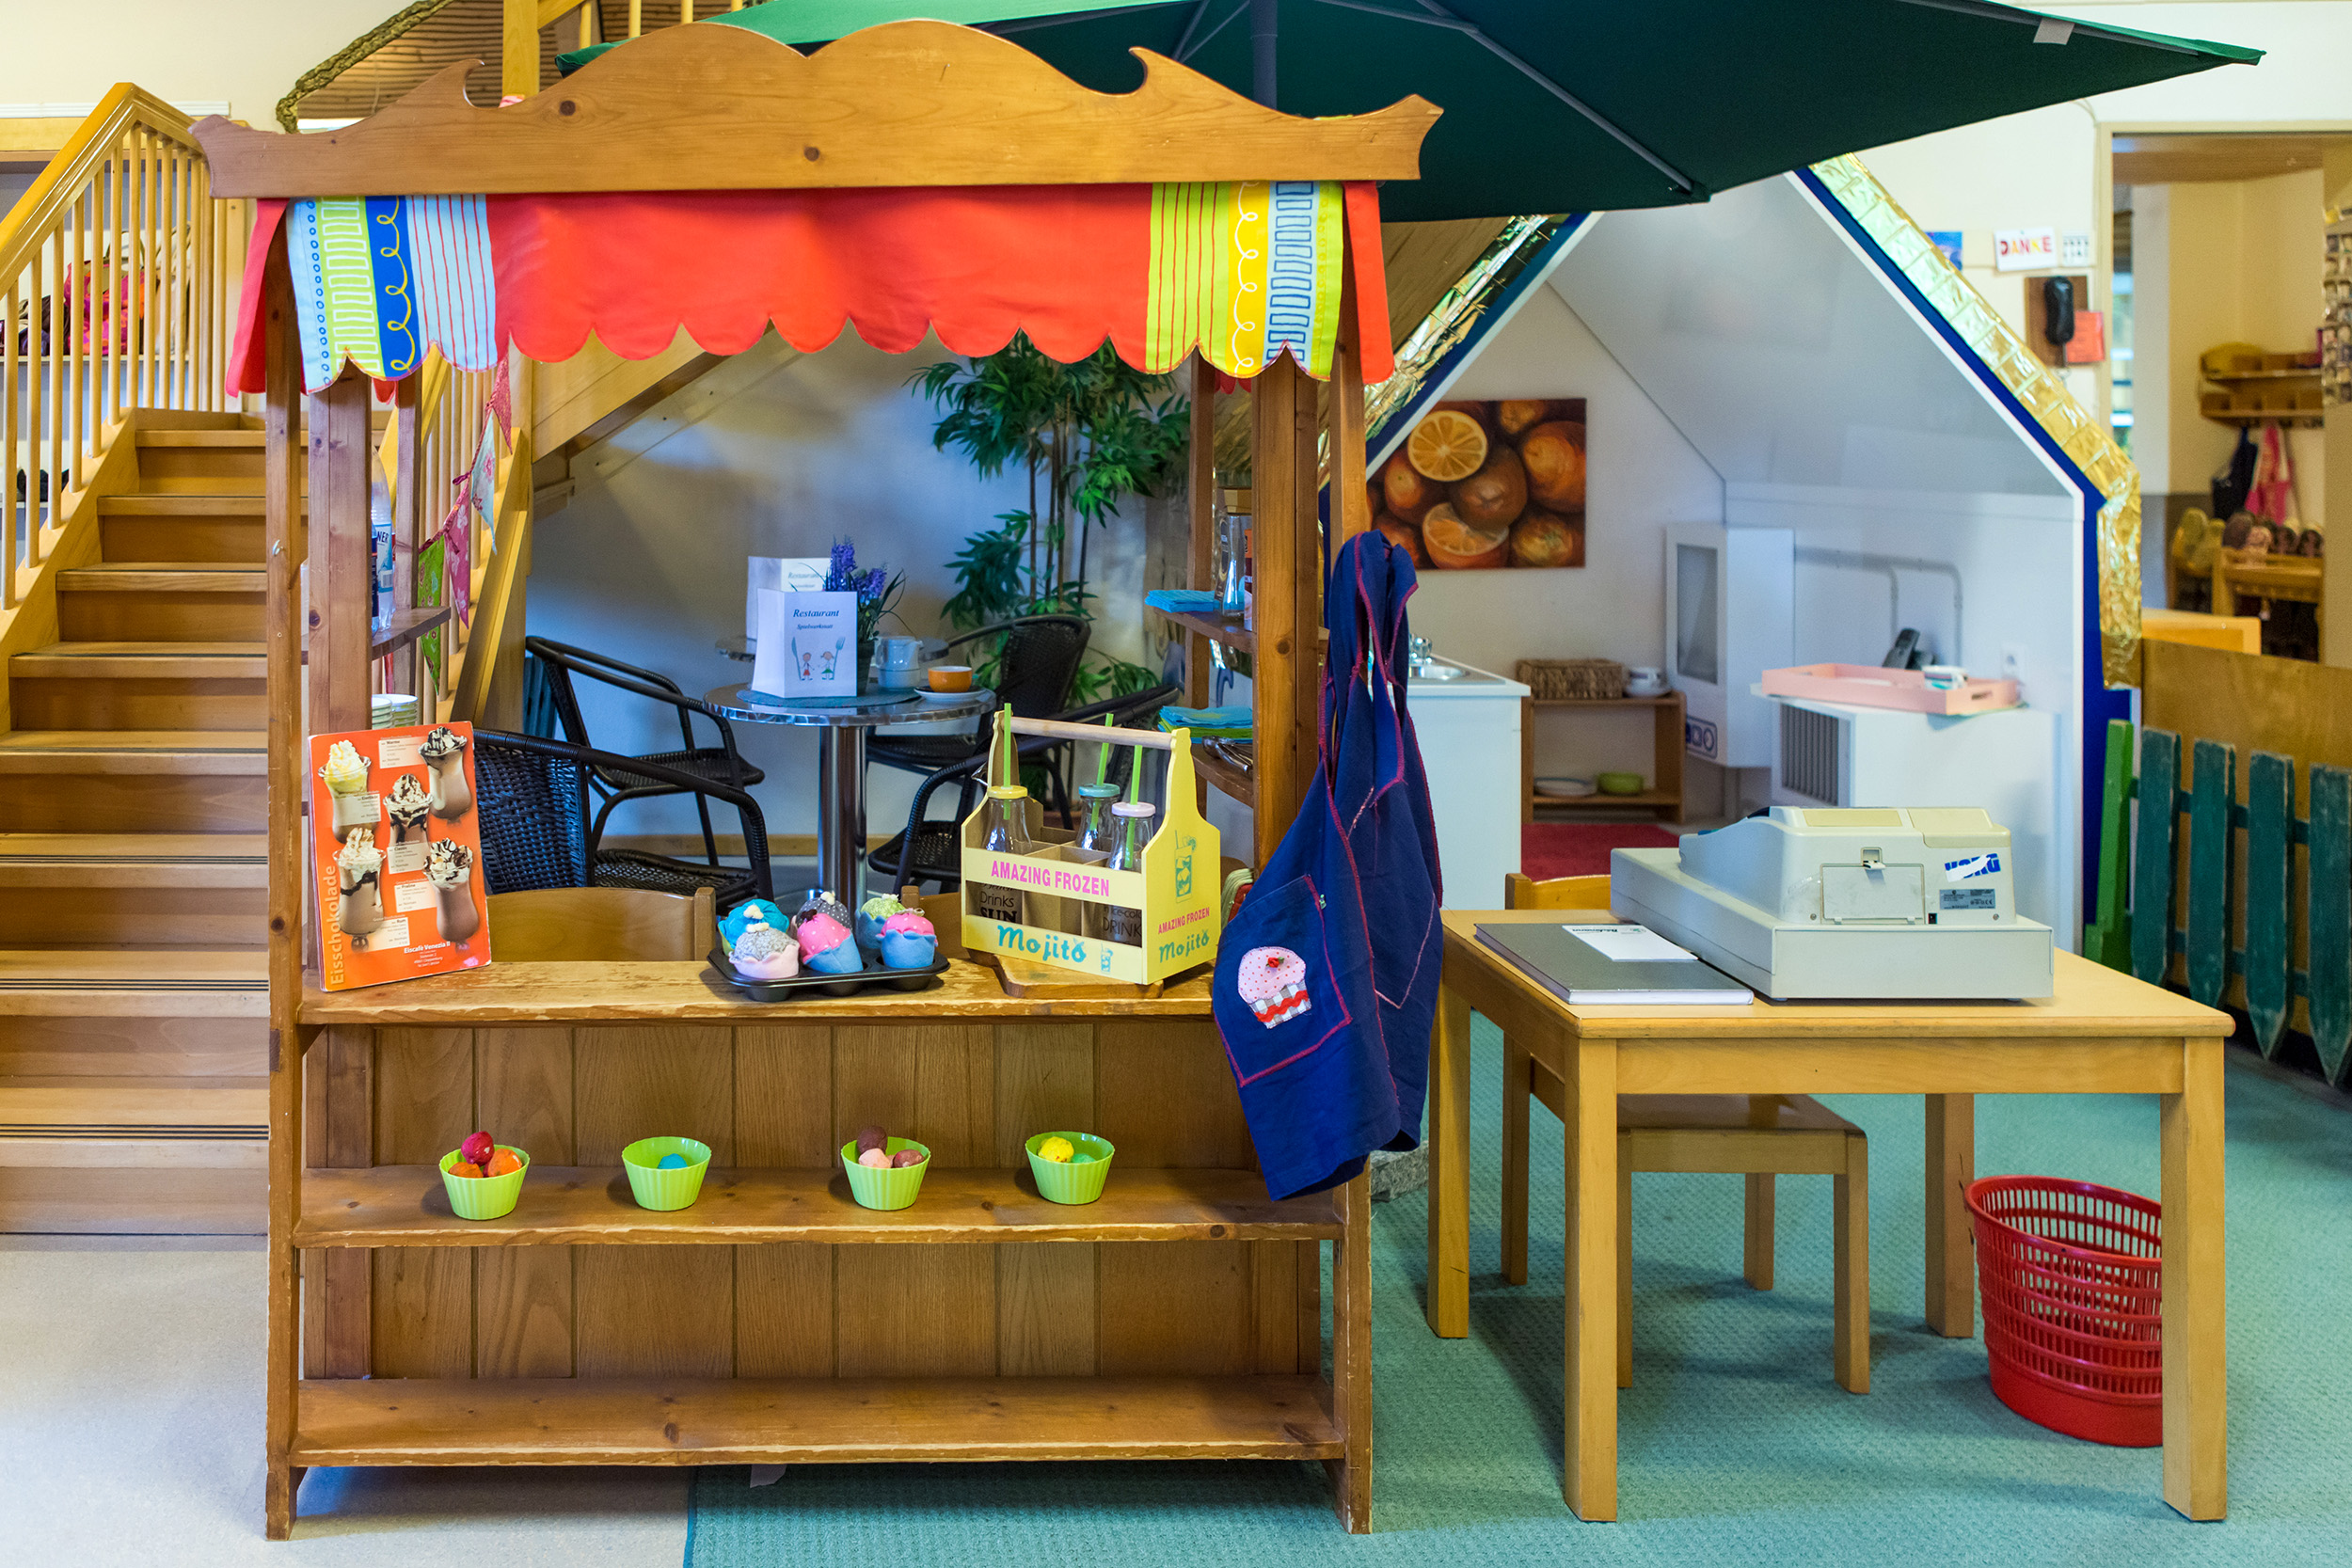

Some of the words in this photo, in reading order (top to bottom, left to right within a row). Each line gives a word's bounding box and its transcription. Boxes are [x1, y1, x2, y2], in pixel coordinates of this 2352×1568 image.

[1999, 236, 2053, 257] DANKE
[792, 609, 840, 618] Restaurant
[991, 860, 1052, 887] AMAZING
[1055, 871, 1111, 897] FROZEN
[980, 891, 1015, 908] Drinks
[324, 865, 344, 986] Eisschokolade
[1158, 914, 1185, 935] AMAZING
[1186, 907, 1210, 927] FROZEN
[424, 942, 446, 950] Venezia
